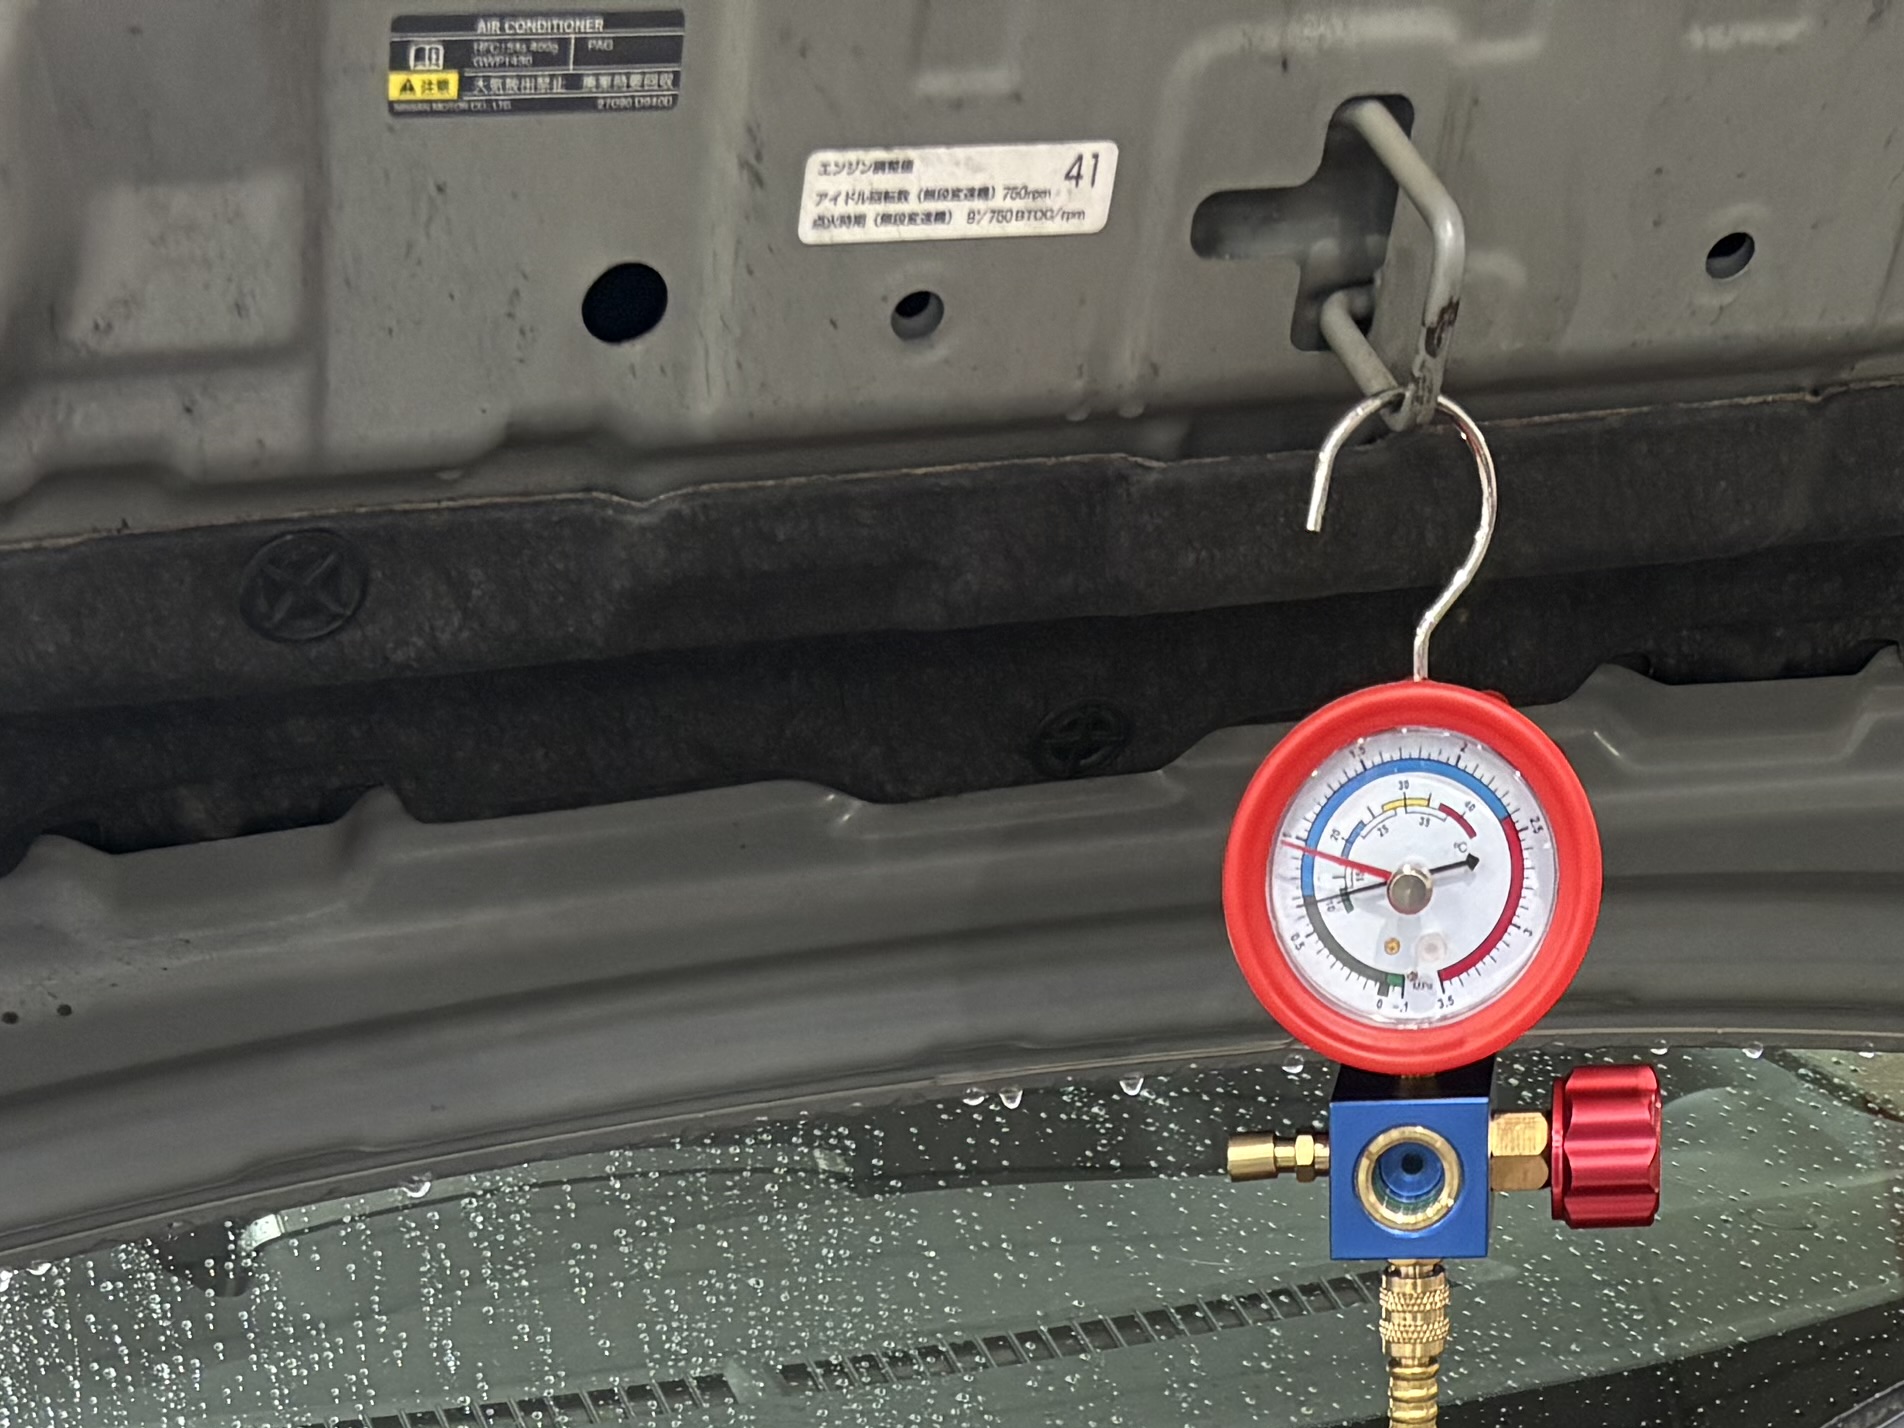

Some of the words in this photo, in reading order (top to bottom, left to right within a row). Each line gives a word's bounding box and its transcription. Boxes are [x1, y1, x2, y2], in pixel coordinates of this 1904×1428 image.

[477, 18, 500, 34] AIR
[504, 16, 604, 34] CONDITIONER
[1063, 152, 1100, 189] 41
[1397, 779, 1410, 791] 30
[1437, 998, 1456, 1010] 3.5
